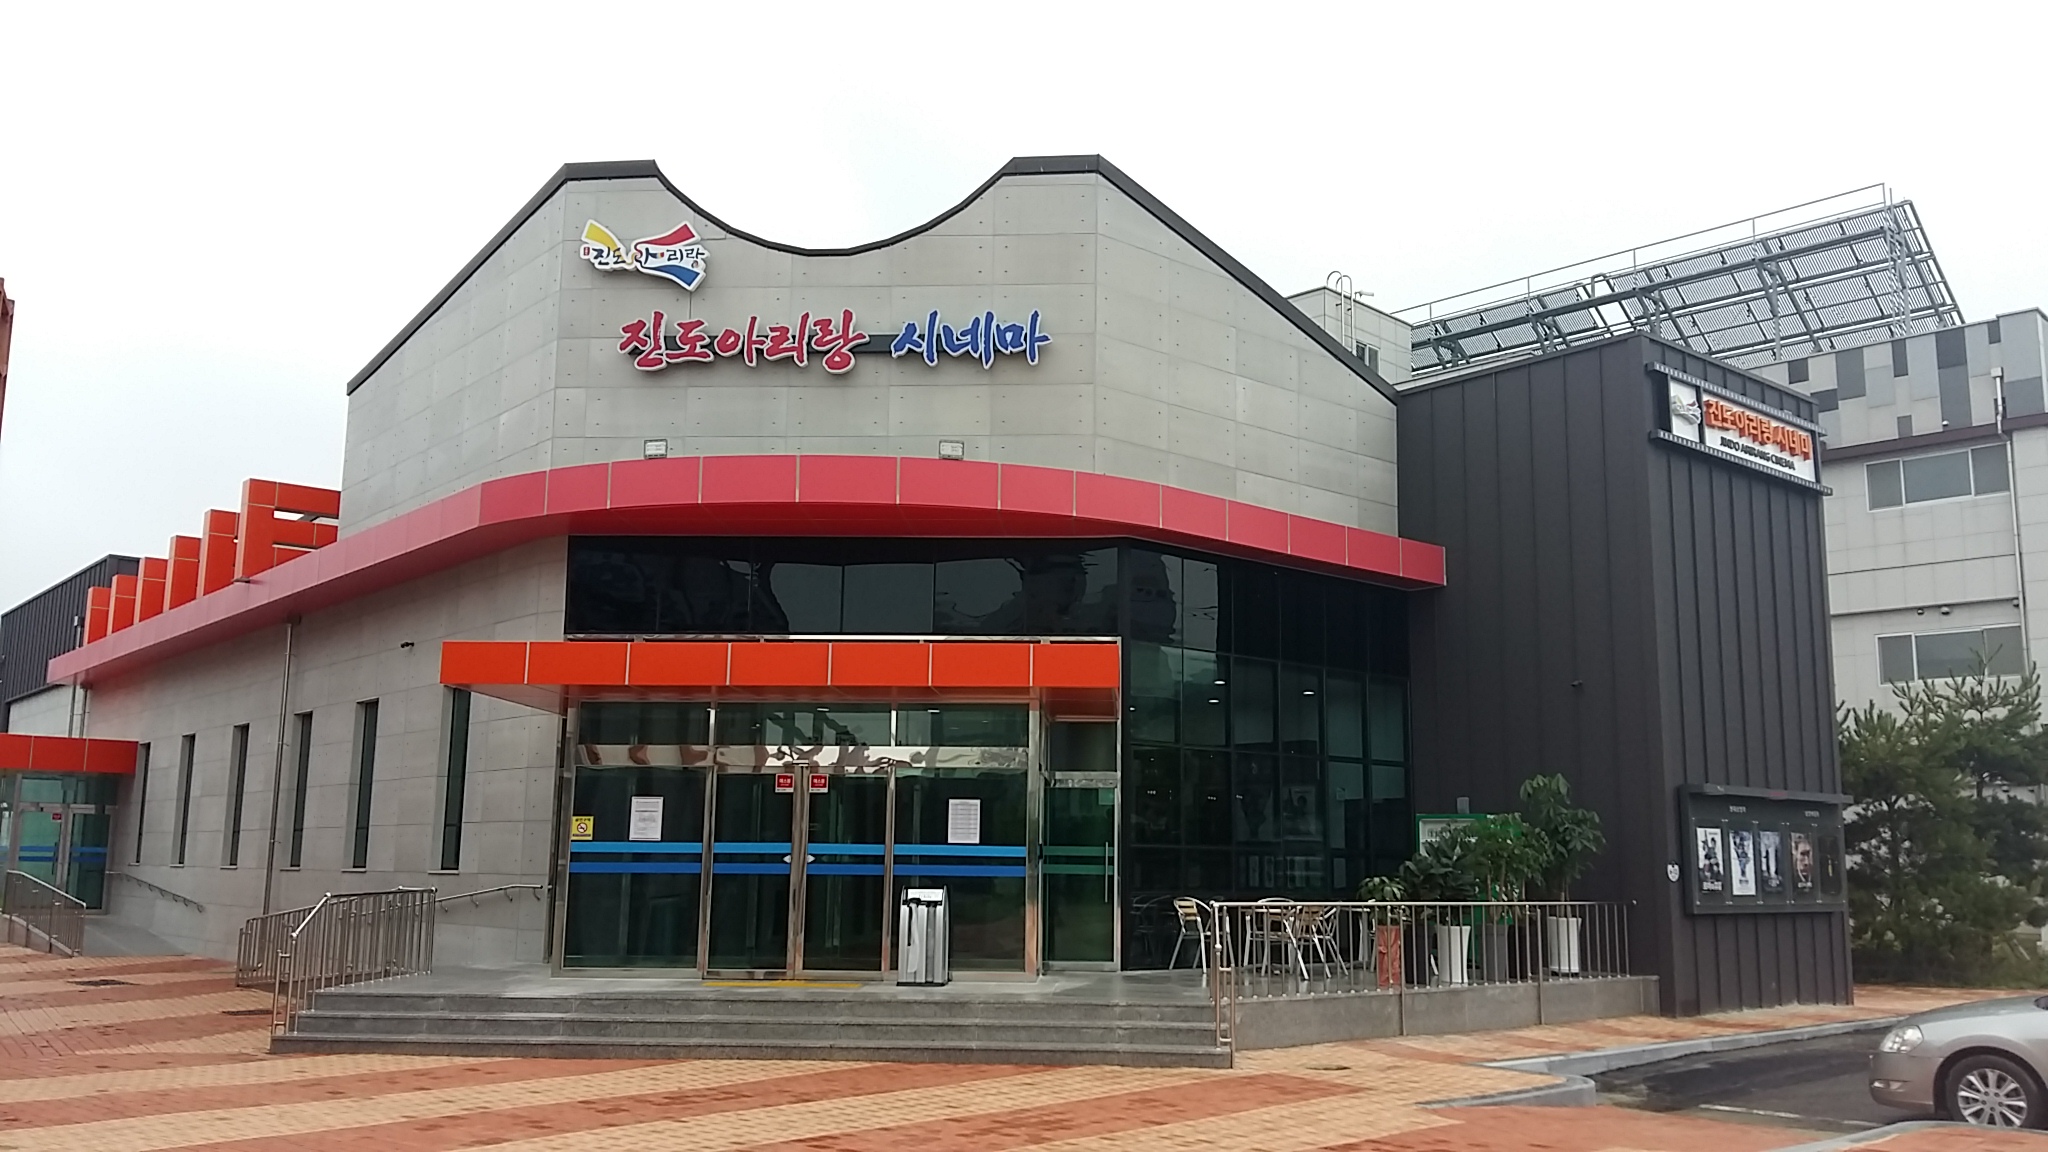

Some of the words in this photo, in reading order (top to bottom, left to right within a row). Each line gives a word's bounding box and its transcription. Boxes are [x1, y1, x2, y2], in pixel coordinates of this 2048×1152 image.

[618, 310, 869, 373] 진도아리랑
[891, 310, 1052, 369] 시네마
[1704, 399, 1774, 445] 진도아리랑
[1776, 425, 1813, 460] 시네마
[1720, 436, 1740, 451] JINDO
[1771, 454, 1796, 471] CINEMA
